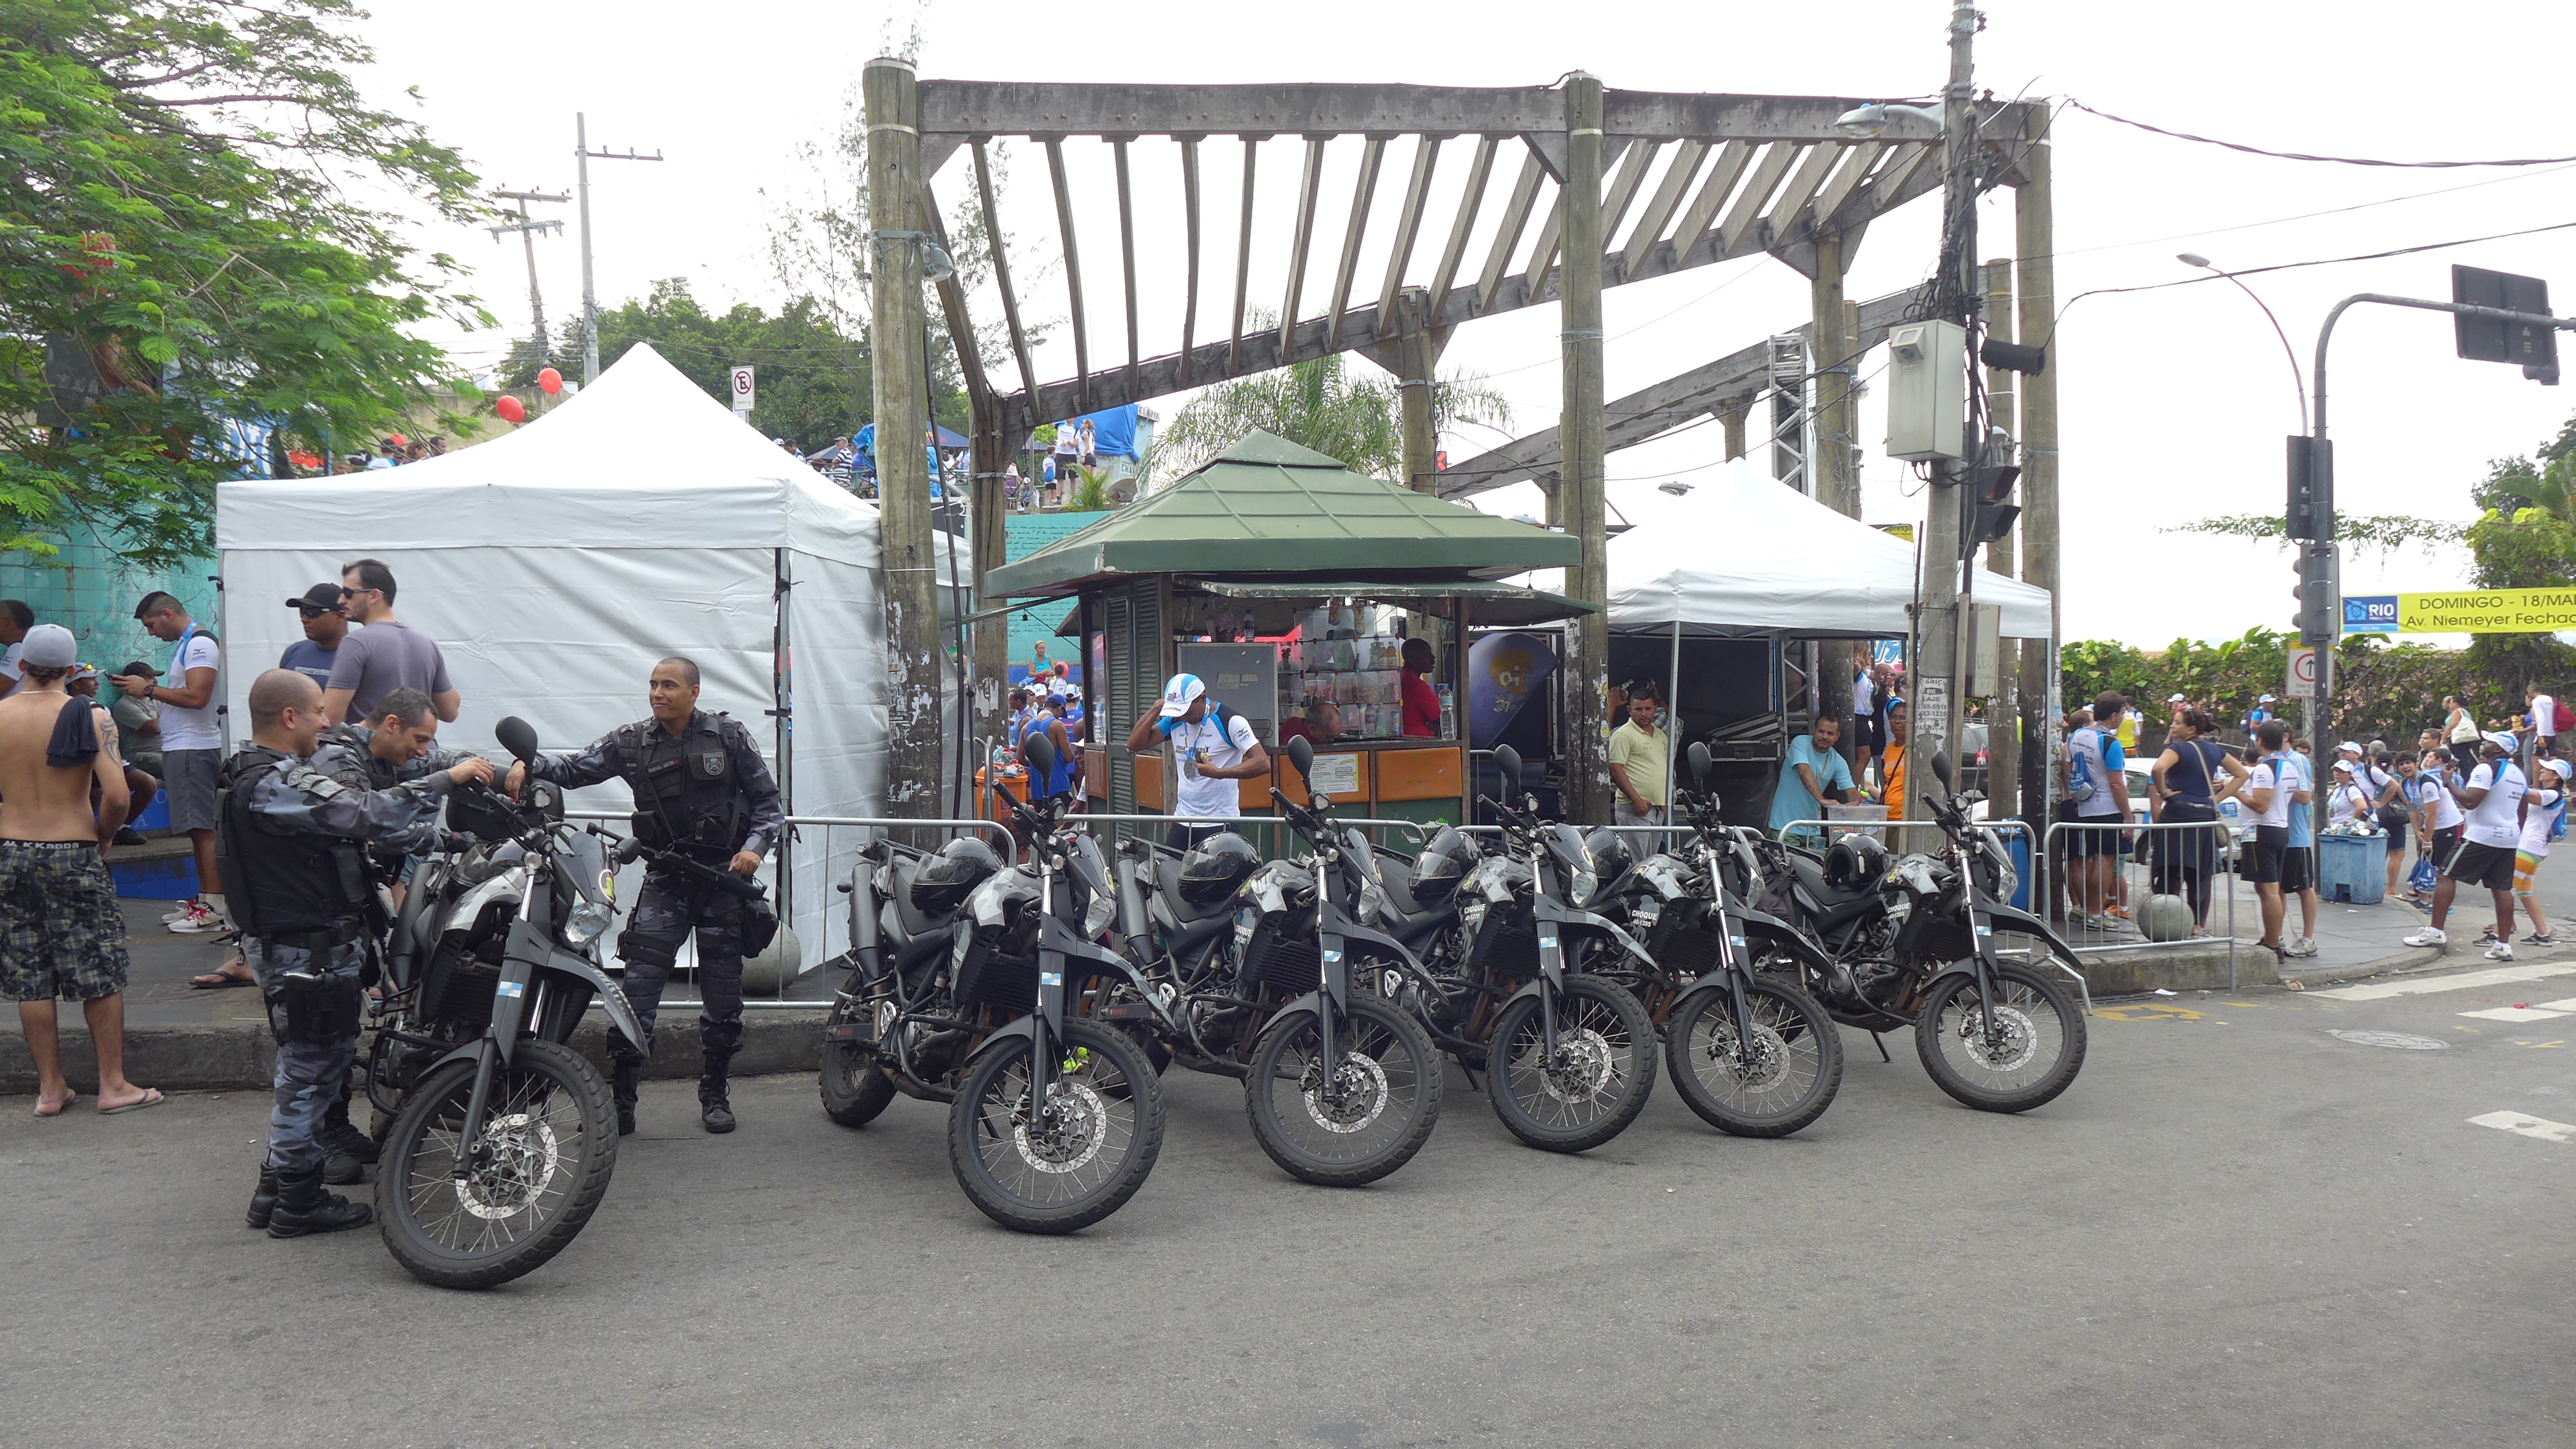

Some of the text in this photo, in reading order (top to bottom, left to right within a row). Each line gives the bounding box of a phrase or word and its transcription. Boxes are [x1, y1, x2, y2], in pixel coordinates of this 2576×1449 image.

[2420, 596, 2503, 610] DOMINGO
[2522, 594, 2576, 607] 18/MA
[2368, 604, 2394, 617] RIO
[2406, 616, 2427, 626] Av.
[2434, 615, 2510, 627] Niemeyer
[1464, 904, 1486, 914] CHOQUE
[1888, 902, 1911, 913] CHOQUE
[1632, 910, 1658, 921] CHOQUE
[1235, 924, 1253, 937] CHOQUE
